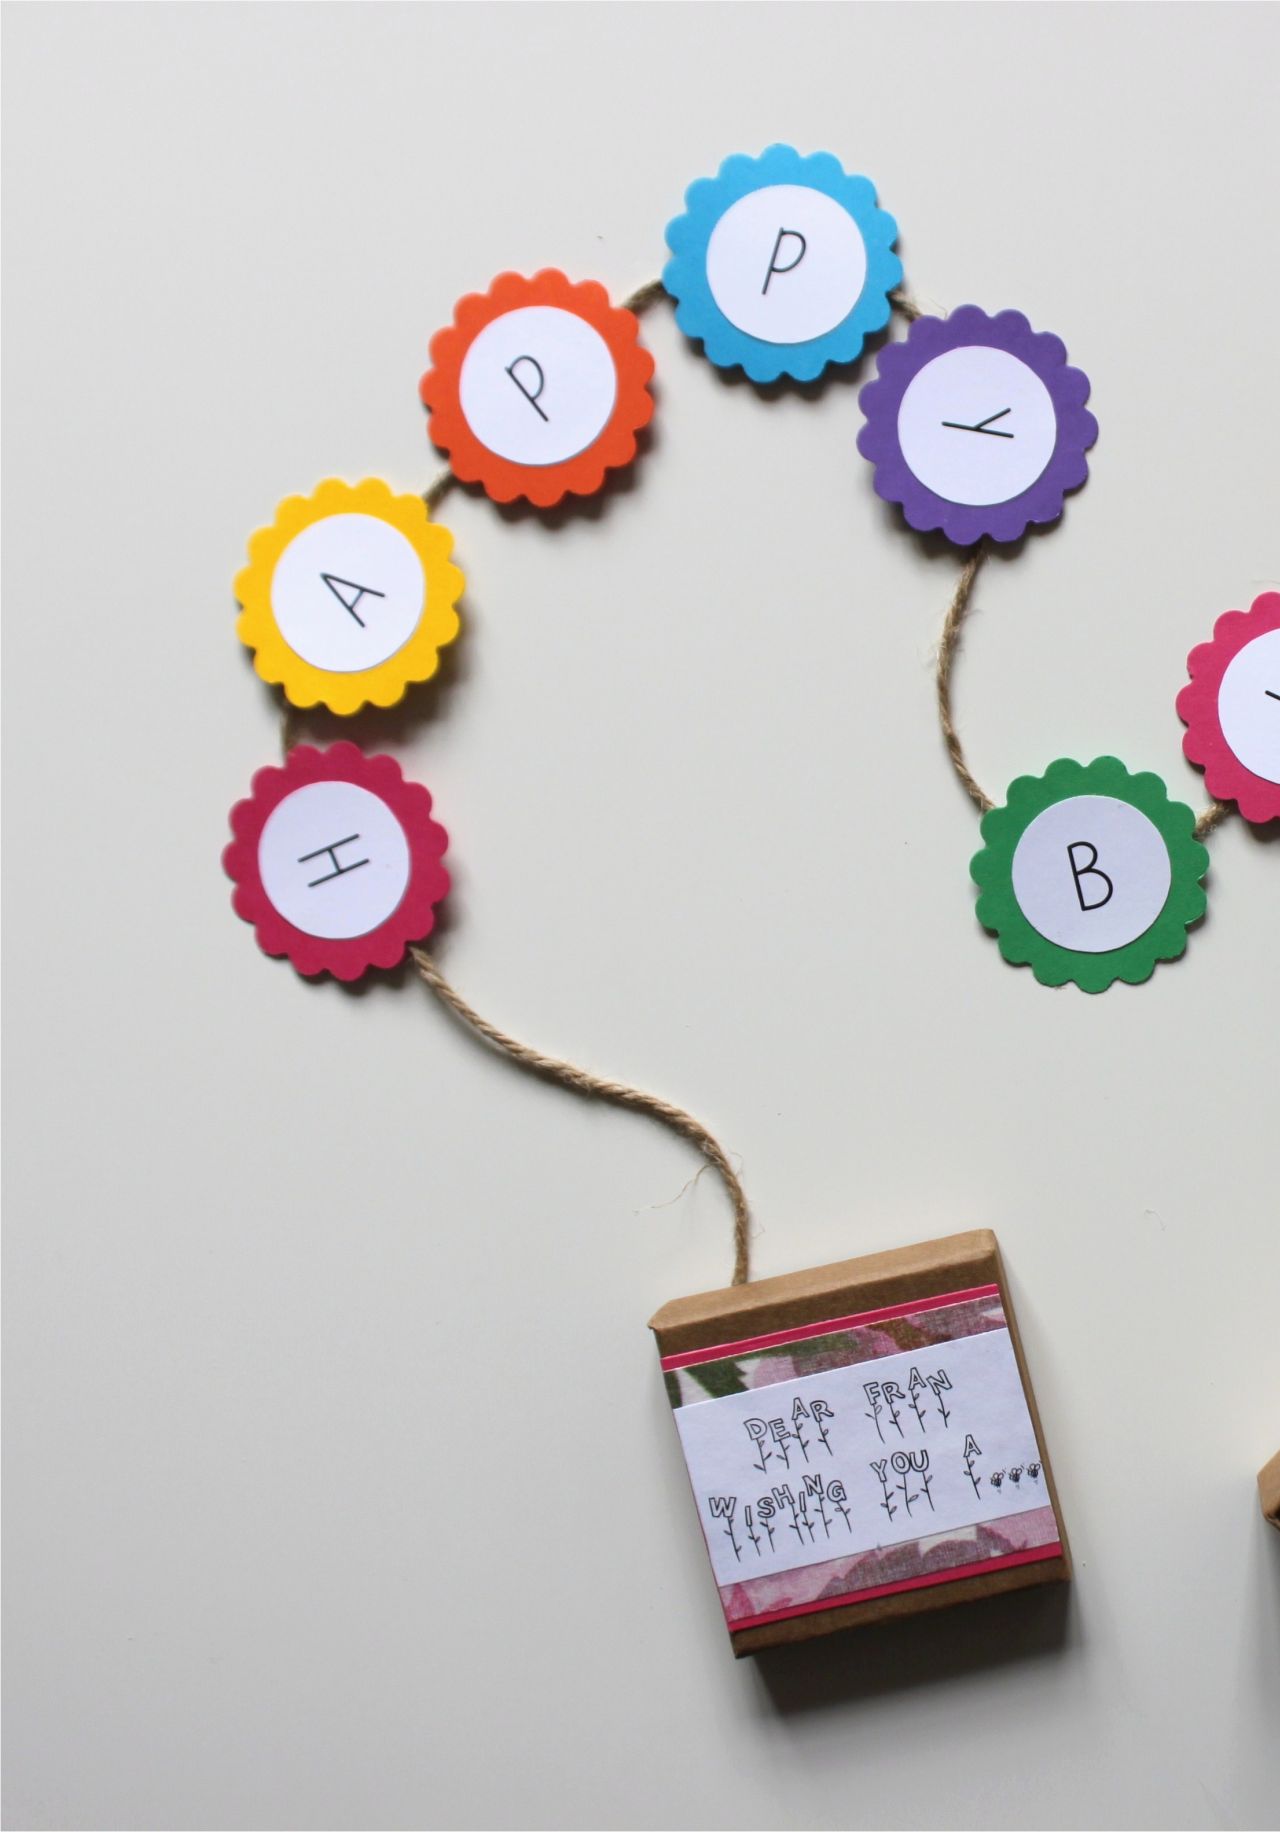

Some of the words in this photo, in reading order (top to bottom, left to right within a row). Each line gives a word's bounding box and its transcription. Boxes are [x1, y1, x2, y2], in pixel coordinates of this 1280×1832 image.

[762, 228, 807, 295] P
[506, 356, 549, 422] P
[941, 407, 1015, 439] Y
[321, 573, 385, 628] A
[298, 833, 370, 888] H
[1066, 840, 1114, 912] B
[744, 1397, 834, 1442] DEAR
[863, 1366, 953, 1405] FRAN
[709, 1474, 847, 1527] WISHING
[869, 1449, 929, 1483] YOU
[963, 1434, 982, 1458] A
